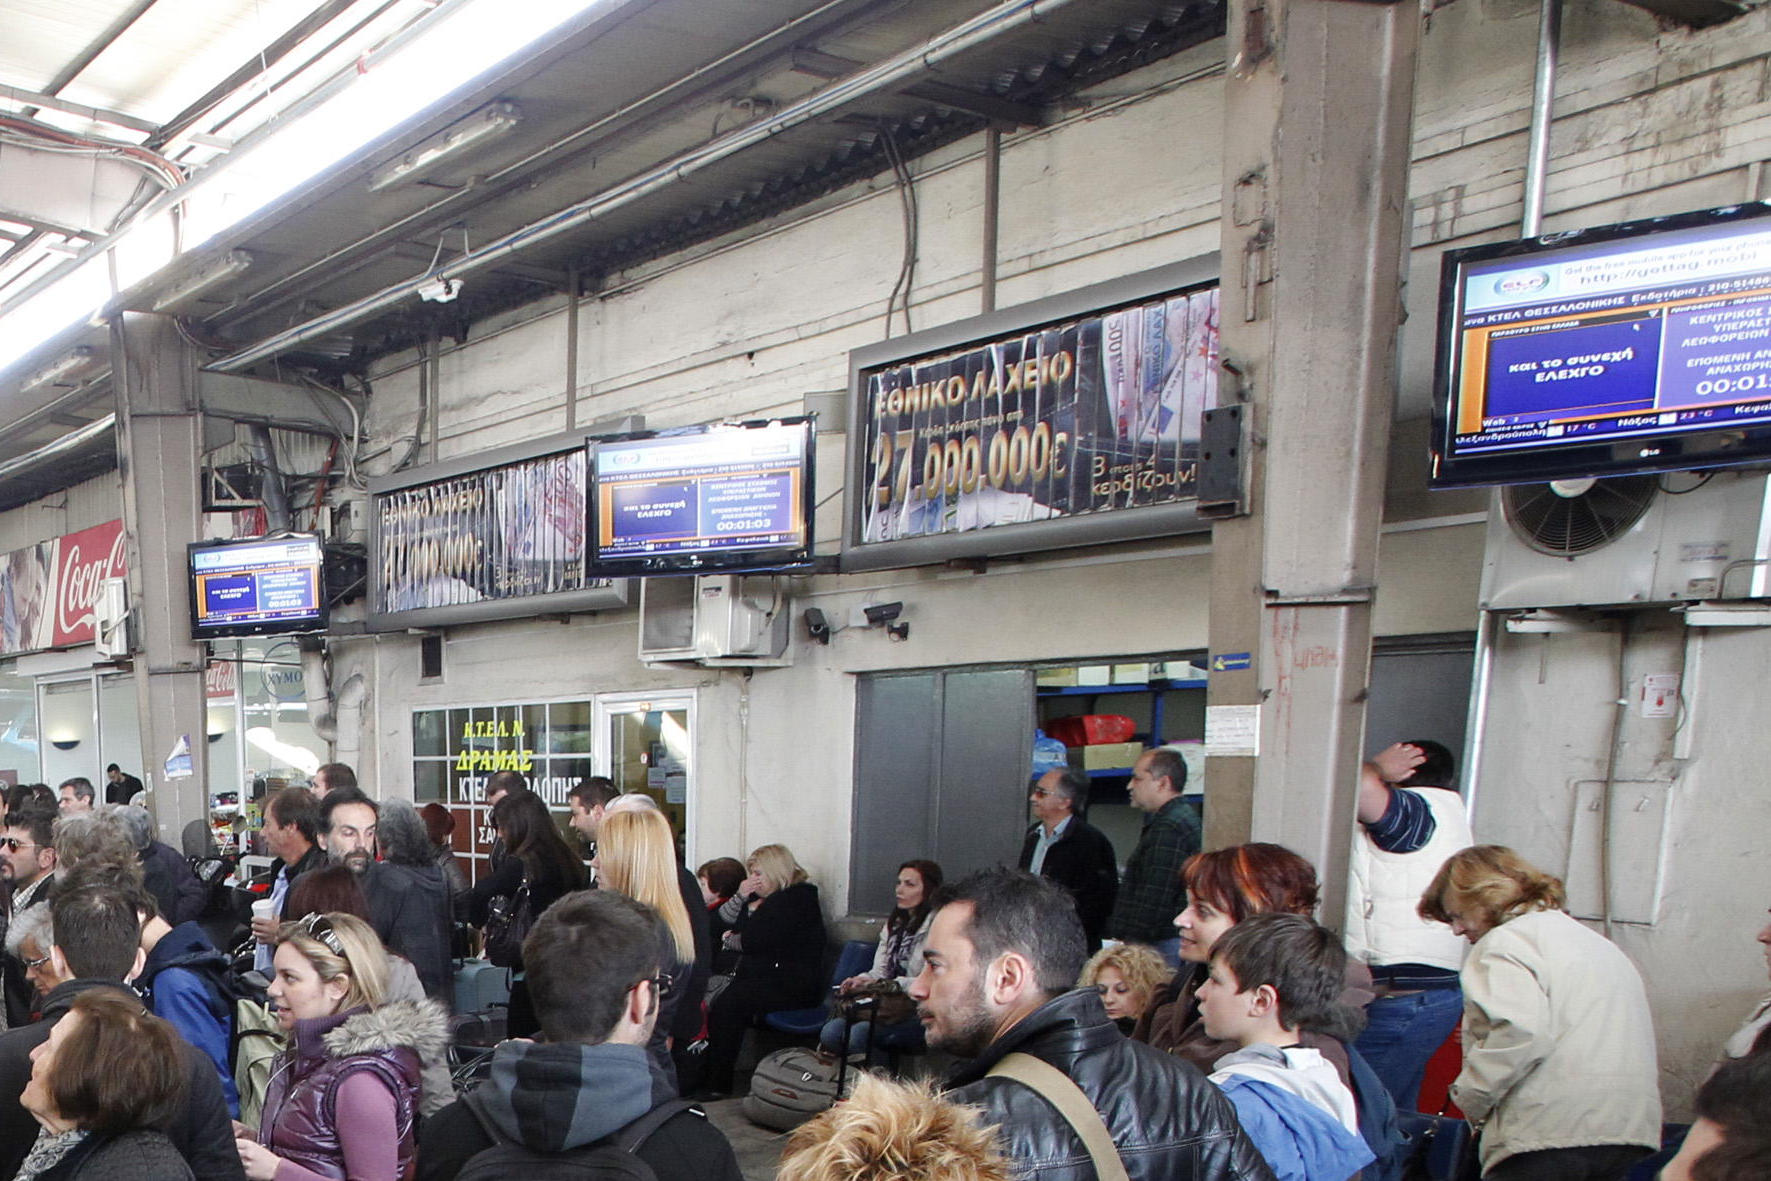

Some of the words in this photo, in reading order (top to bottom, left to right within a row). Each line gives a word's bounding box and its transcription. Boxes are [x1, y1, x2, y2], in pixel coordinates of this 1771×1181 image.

[1487, 311, 1521, 323] ΚΤΕΛ
[1524, 296, 1626, 318] ΘΕΣΣΑΛΟΝΙΚΗΣ
[1690, 307, 1764, 326] ΚΕΝΤΡΙΚΟΣ
[1713, 317, 1771, 333] ΥΠΕΡΑΣΤ
[1509, 362, 1538, 373] και
[1542, 358, 1562, 368] το
[1566, 346, 1634, 366] συνεχή
[1687, 351, 1752, 368] ΕΠΟΜΕΝΗ
[1535, 365, 1604, 383] ΕΛΕΧΓΟ
[874, 374, 966, 420] ΕΘΝΙΚΟ
[971, 350, 1074, 401] ΛΑΧΕΙΟ
[1091, 462, 1197, 497] κερδίζουν!
[637, 509, 672, 519] ΕΛΕΧΓΟ
[717, 518, 771, 531] 00:01:03
[267, 670, 303, 685] ΧΥΜΟ
[456, 750, 533, 771] ΔΡΑΜΑΣ
